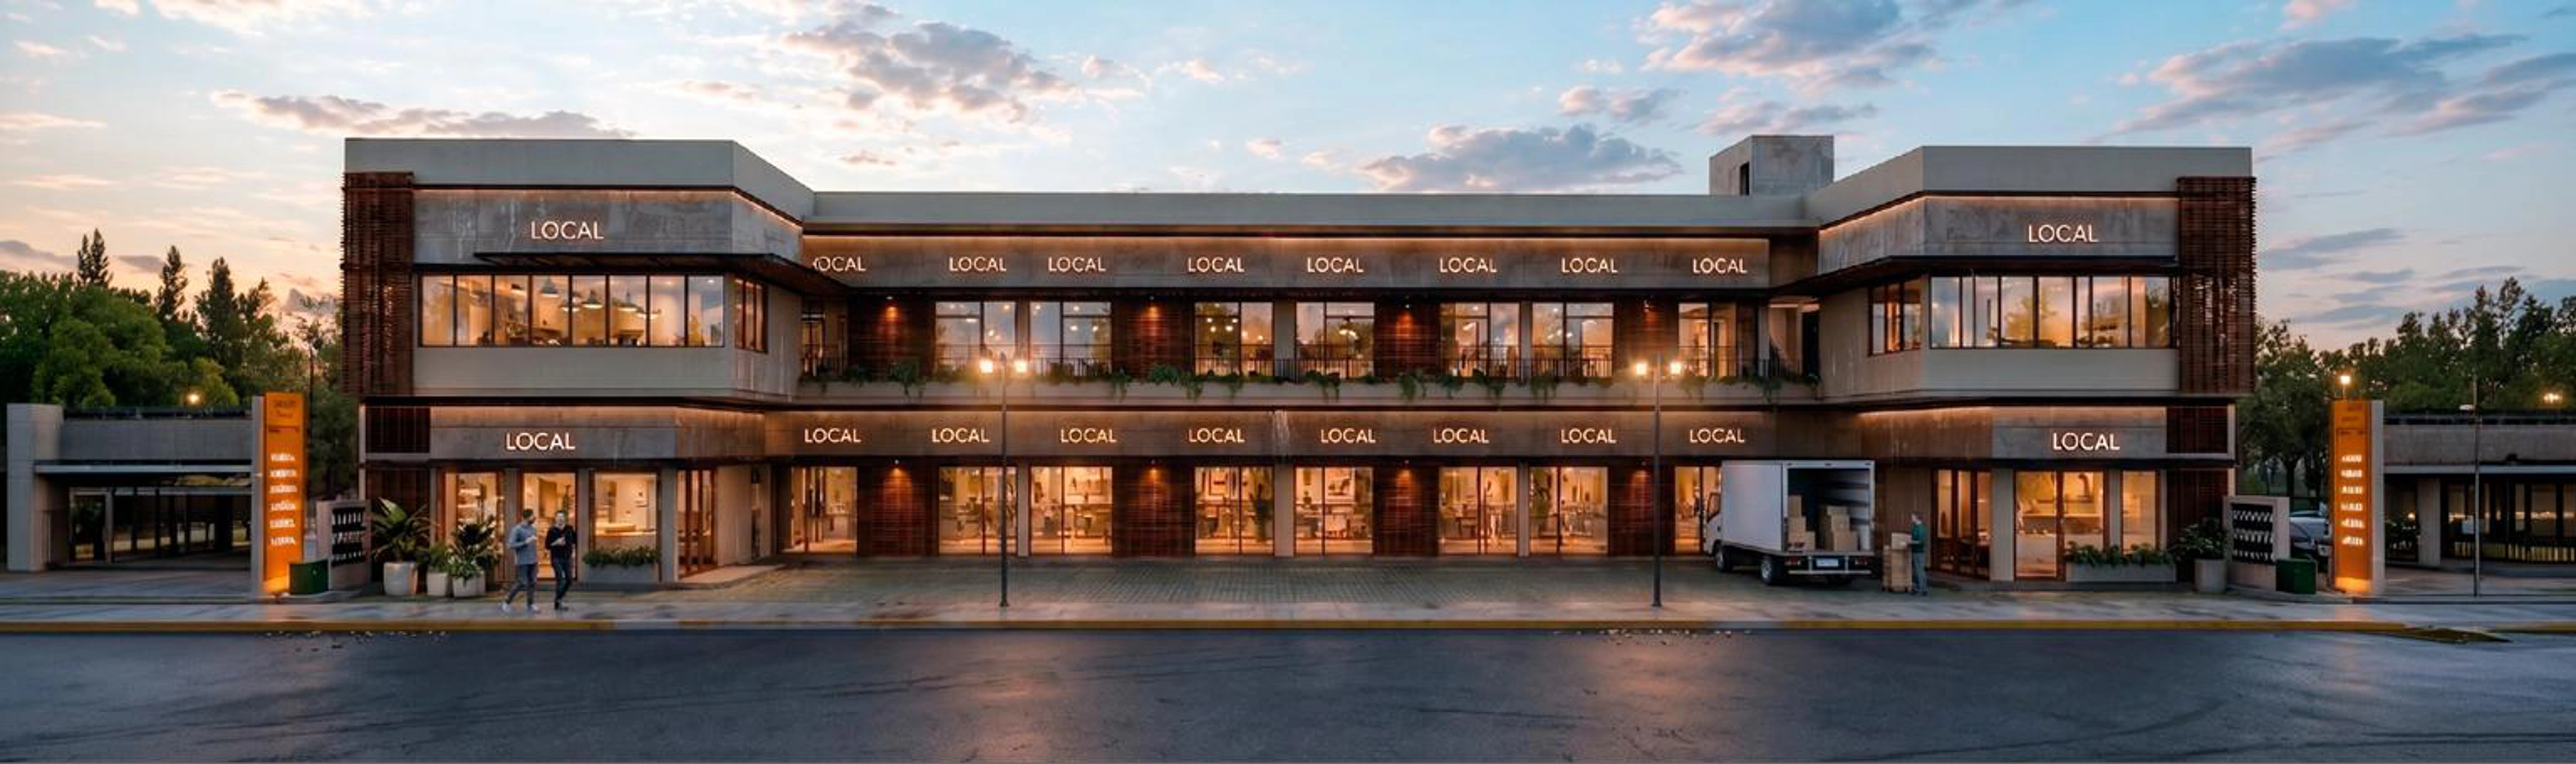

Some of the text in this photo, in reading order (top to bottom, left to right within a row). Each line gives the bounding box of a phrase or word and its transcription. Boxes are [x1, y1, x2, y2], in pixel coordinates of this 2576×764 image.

[531, 221, 604, 239] LOCAL
[2029, 224, 2099, 242] LOCAL
[949, 256, 1007, 272] LOCAL
[1048, 256, 1106, 272] LOCAL
[1188, 257, 1245, 273] LOCAL
[1307, 257, 1364, 273] LOCAL
[1440, 257, 1497, 273] LOCAL
[1561, 257, 1618, 273] LOCAL
[1693, 258, 1748, 274] LOCAL
[506, 432, 576, 450] LOCAL
[804, 427, 861, 444] LOCAL
[932, 427, 990, 443] LOCAL
[1060, 427, 1117, 443] LOCAL
[1188, 427, 1245, 443] LOCAL
[1321, 428, 1376, 444] LOCAL
[1433, 428, 1489, 444] LOCAL
[1561, 428, 1617, 444] LOCAL
[1690, 427, 1745, 444] LOCAL
[2053, 432, 2121, 451] LOCAL
